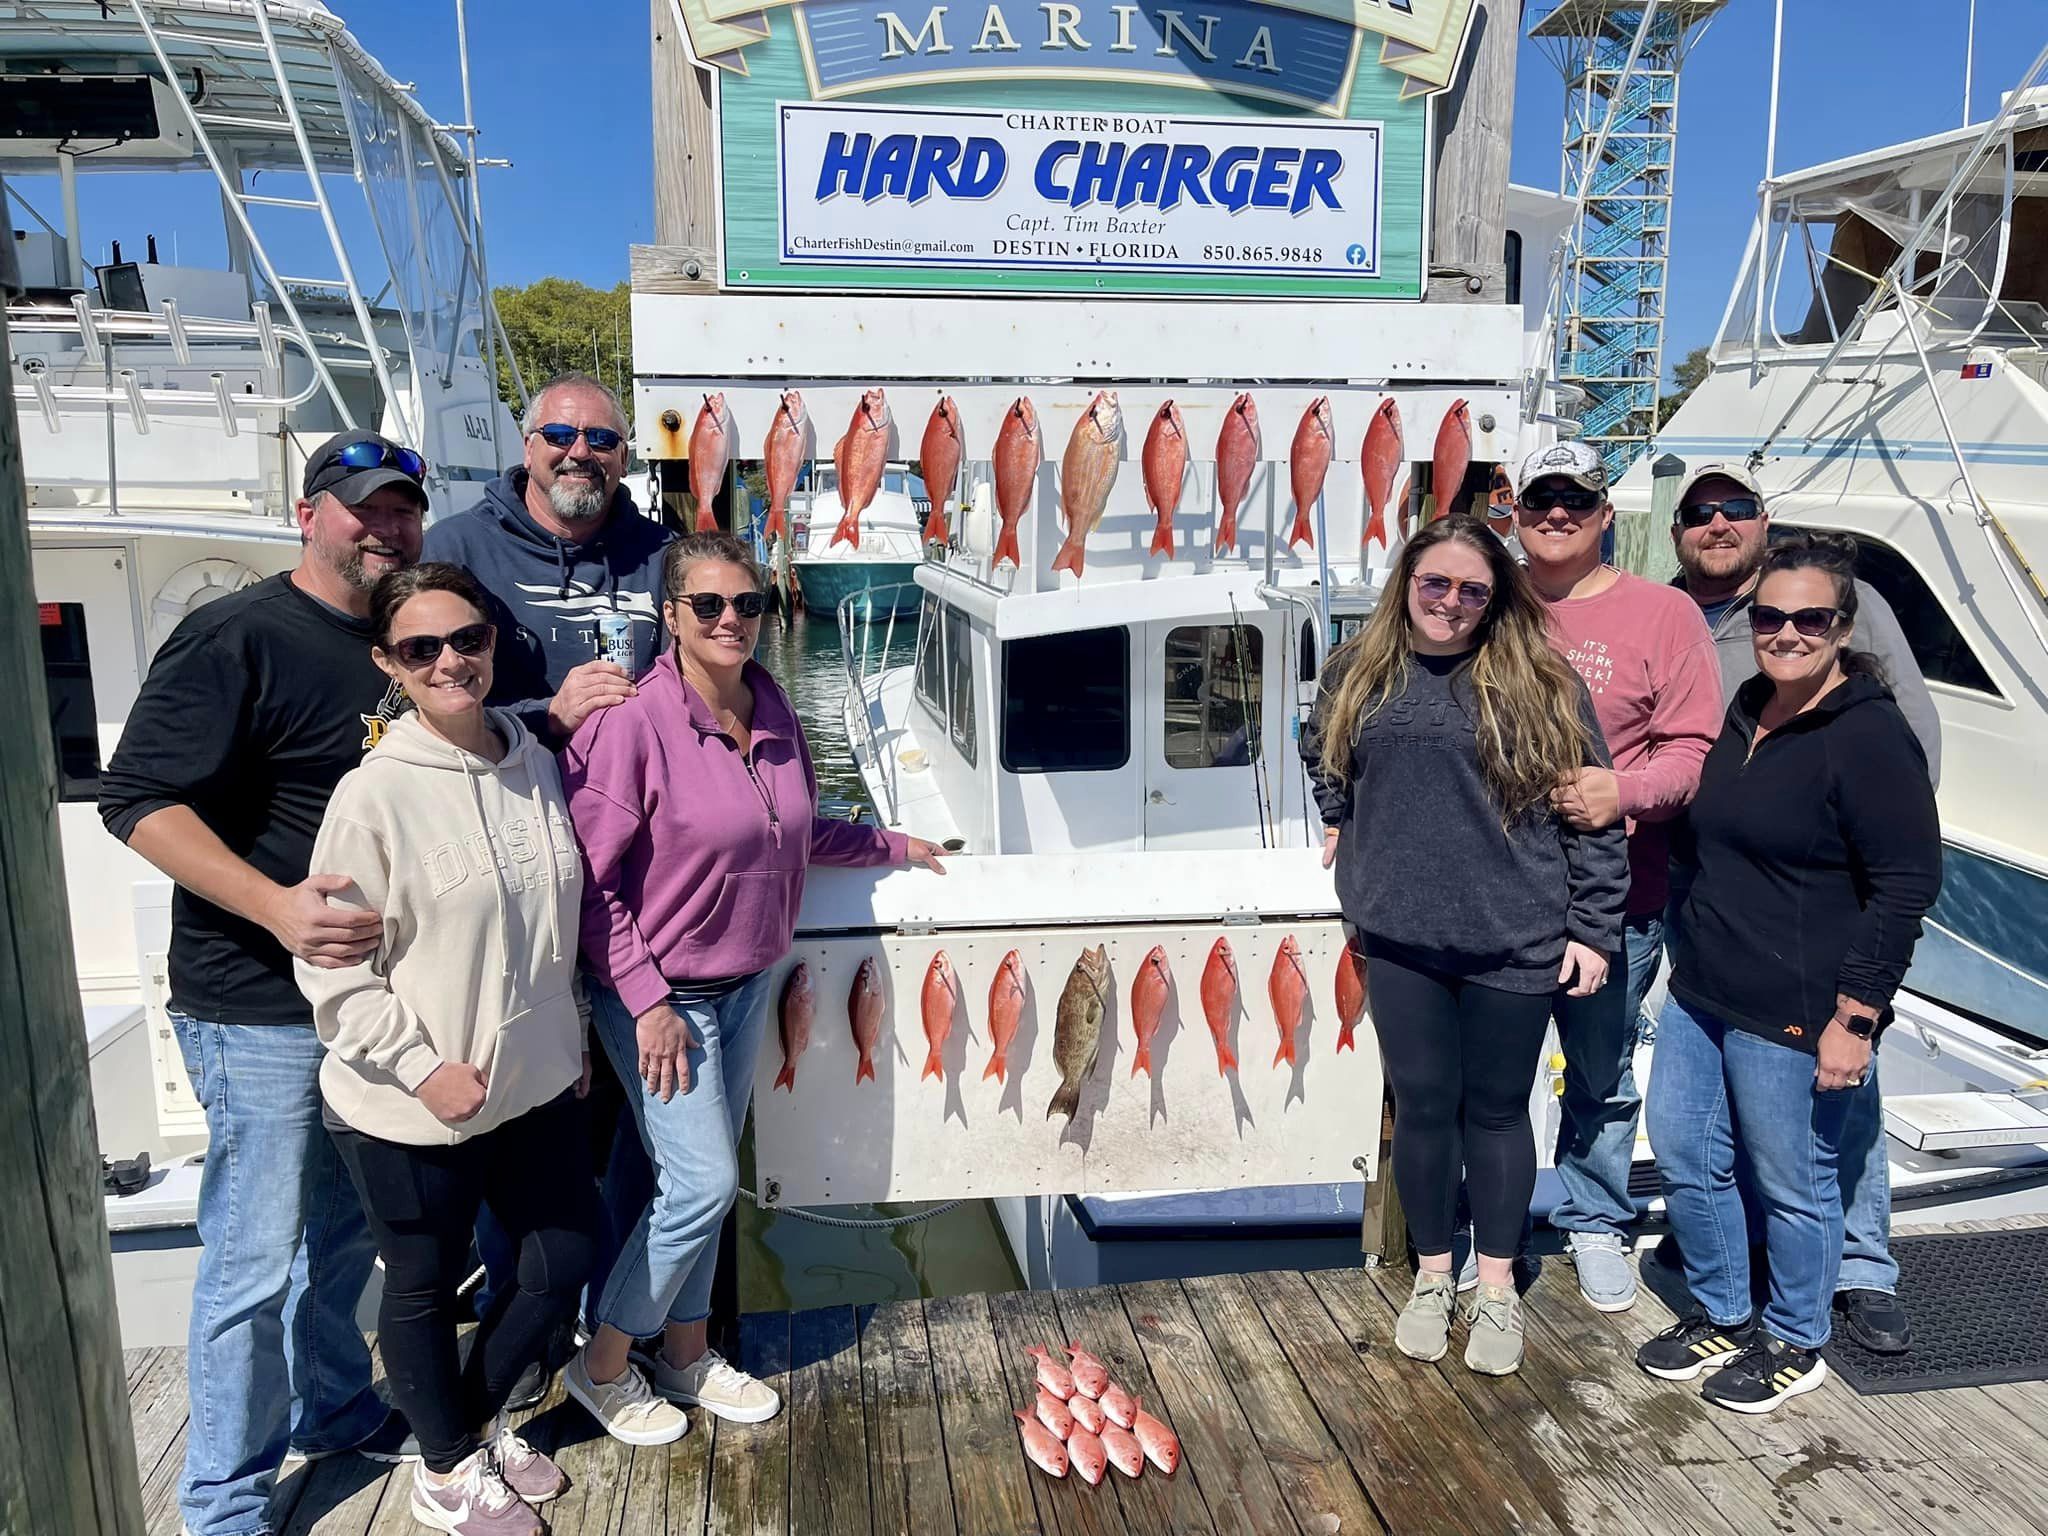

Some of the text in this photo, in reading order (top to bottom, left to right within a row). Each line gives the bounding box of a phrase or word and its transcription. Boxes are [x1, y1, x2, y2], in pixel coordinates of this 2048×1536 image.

[876, 2, 1284, 74] MARINA
[1006, 114, 1167, 135] CHARTER BOAT
[815, 131, 1346, 218] HARD CHARGER
[1005, 213, 1167, 236] Capt. Tim Baxter
[793, 236, 974, 254] CharterFishDestin@gmail.com
[992, 240, 1179, 260] DESTIN FLORIDA
[1203, 245, 1323, 263] 850.865.9848
[515, 625, 658, 645] SITA
[1583, 639, 1608, 654] IT'S
[1566, 649, 1614, 669] SHARK
